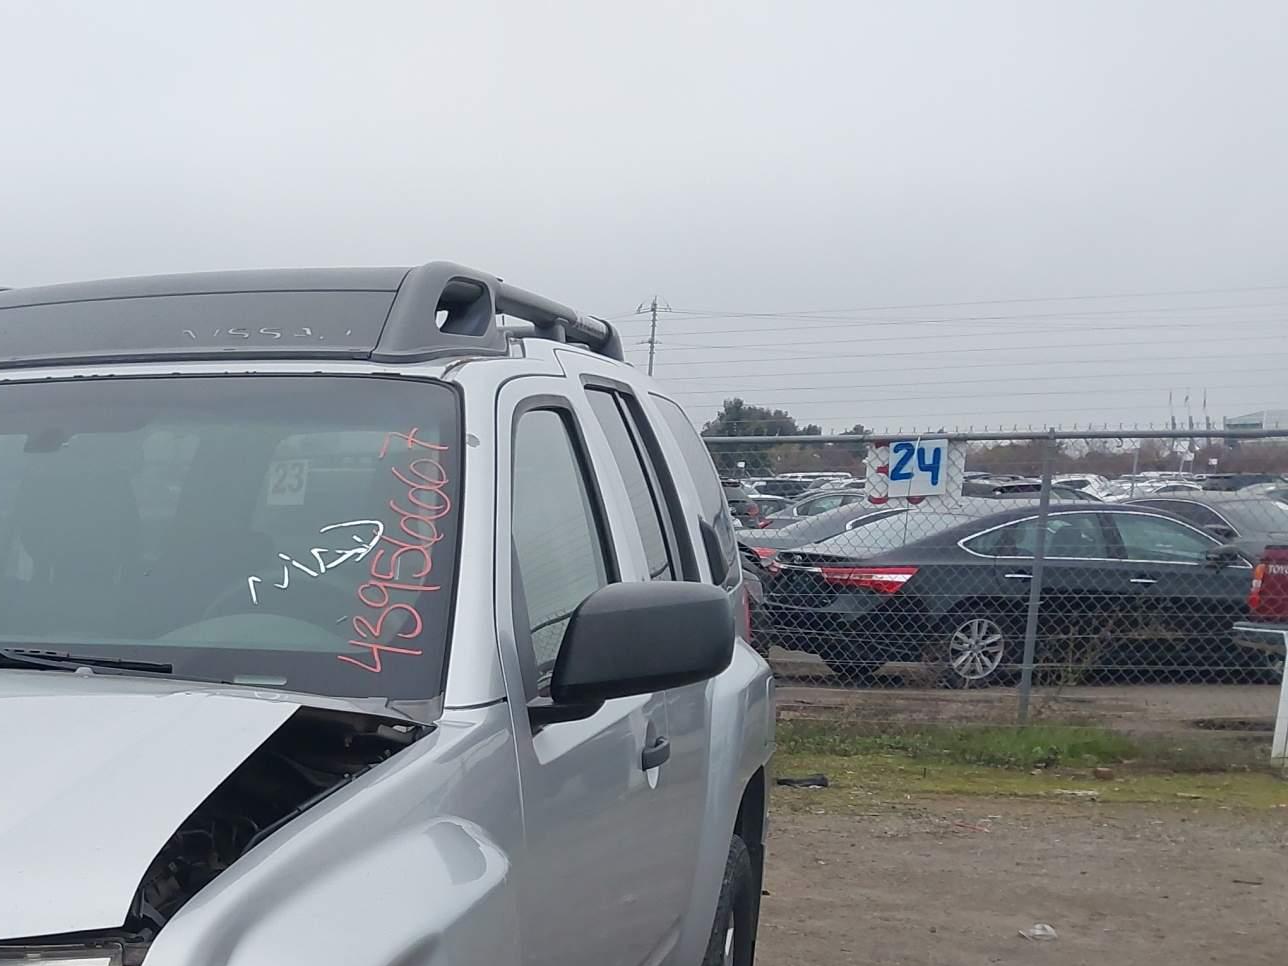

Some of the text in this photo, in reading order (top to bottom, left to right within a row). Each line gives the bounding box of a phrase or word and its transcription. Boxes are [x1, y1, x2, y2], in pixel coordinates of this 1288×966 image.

[271, 463, 305, 495] 23
[890, 442, 941, 486] 24
[337, 427, 451, 673] 43956667
